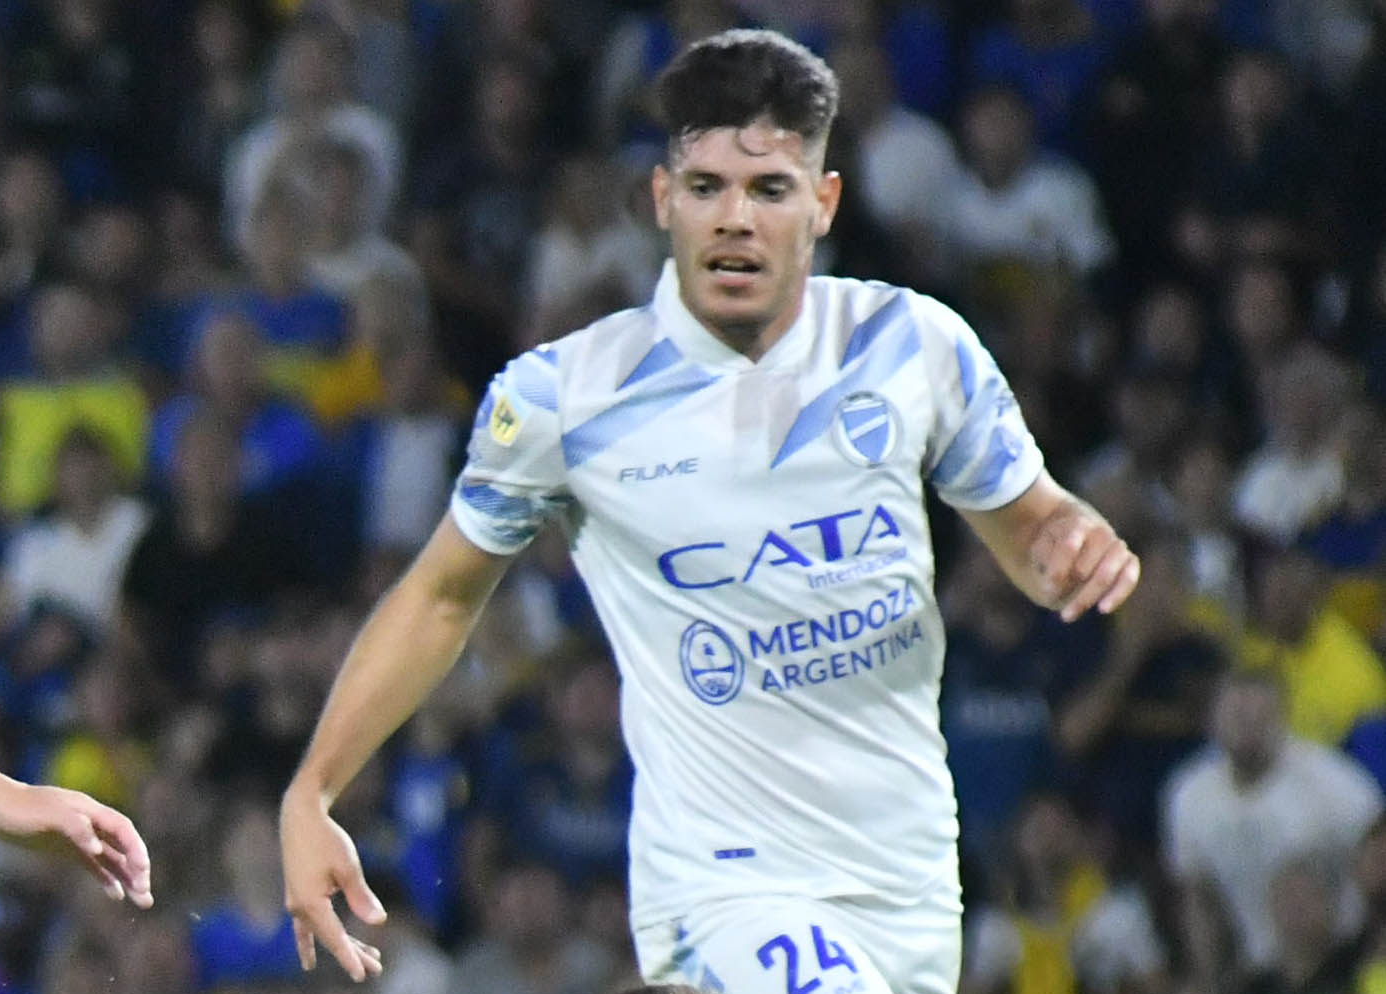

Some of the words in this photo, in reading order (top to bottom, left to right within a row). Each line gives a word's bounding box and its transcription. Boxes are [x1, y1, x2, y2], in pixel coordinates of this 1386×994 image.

[657, 503, 902, 590] CATA
[747, 580, 915, 659] MENDOZA
[760, 619, 926, 693] ARGENTINA
